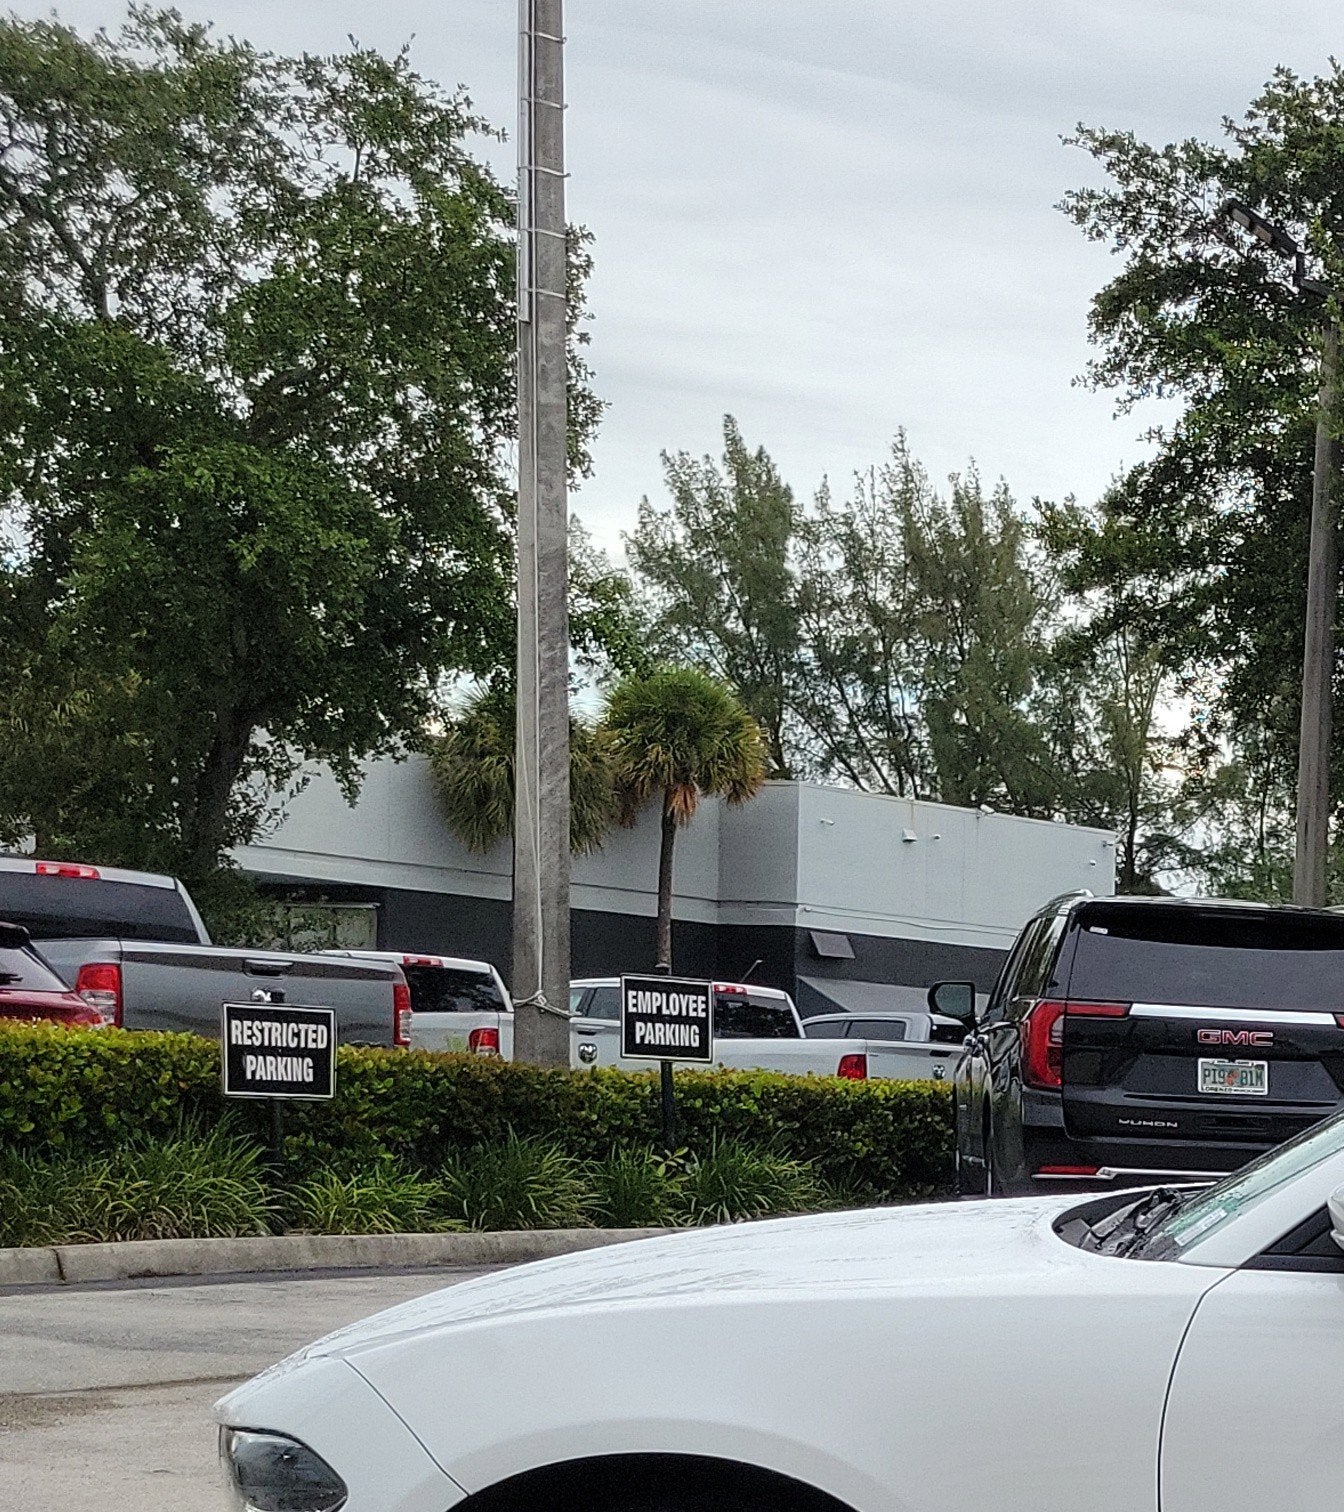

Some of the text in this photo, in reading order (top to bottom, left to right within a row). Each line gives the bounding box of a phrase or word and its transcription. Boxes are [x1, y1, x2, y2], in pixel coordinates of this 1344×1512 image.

[627, 989, 706, 1018] EMPLOYEE
[230, 1019, 328, 1049] RESTRICTED
[635, 1021, 700, 1048] PARKING
[1197, 1029, 1274, 1047] GMC
[245, 1054, 314, 1083] PARKING
[1118, 1118, 1178, 1128] YUKON
